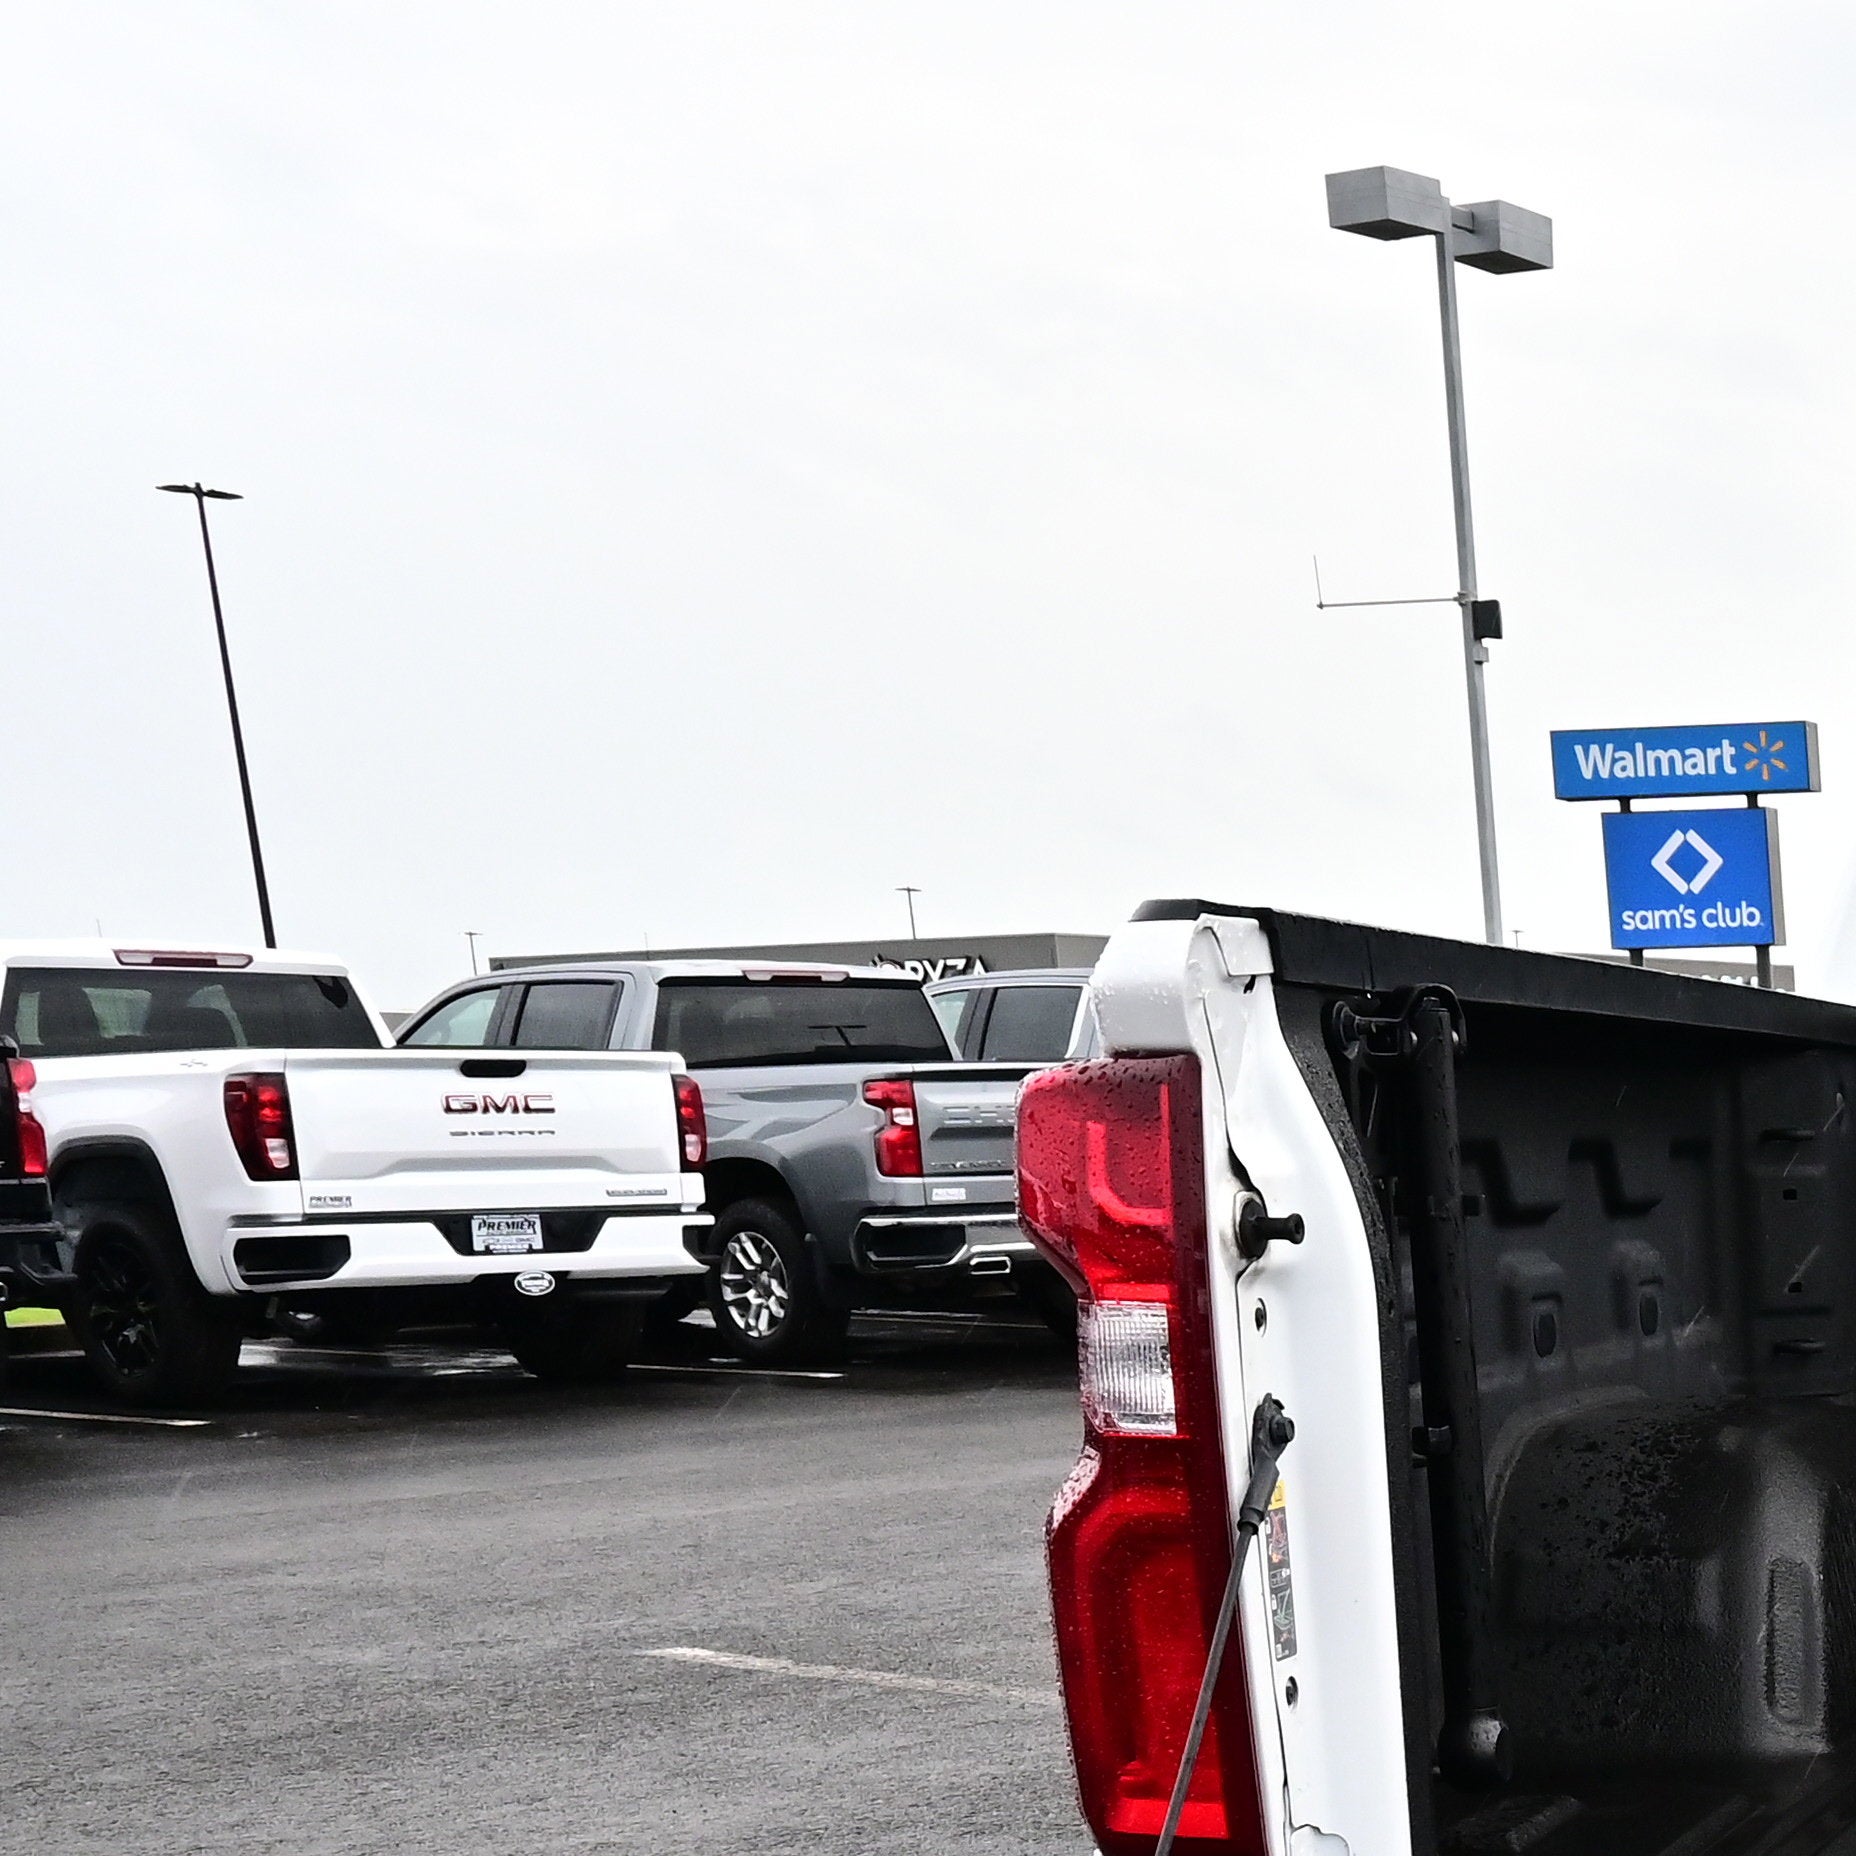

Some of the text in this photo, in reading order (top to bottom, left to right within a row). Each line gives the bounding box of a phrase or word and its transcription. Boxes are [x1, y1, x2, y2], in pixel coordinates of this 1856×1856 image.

[1574, 739, 1737, 779] Walmart
[1621, 900, 1761, 931] sam's club
[442, 1093, 556, 1115] GMC
[477, 1218, 537, 1235] PREMIER
